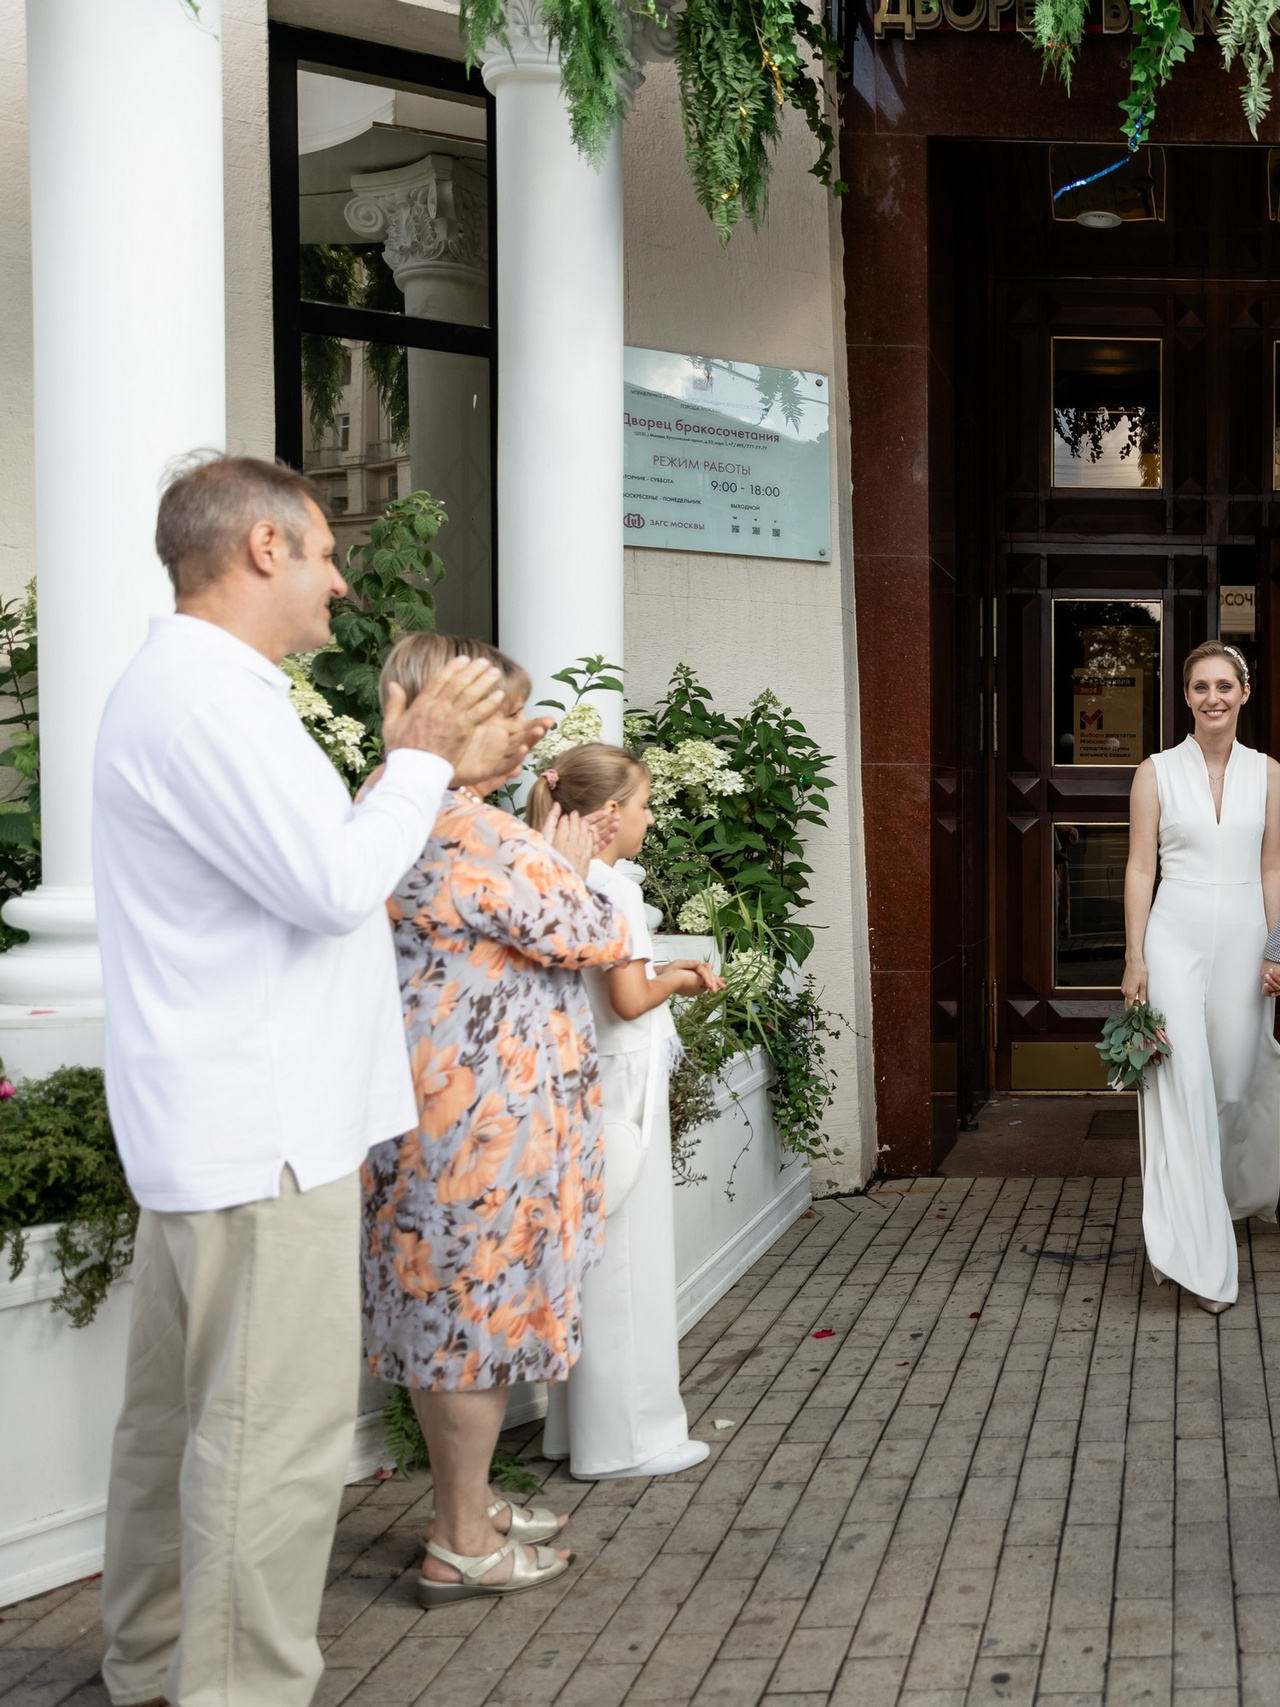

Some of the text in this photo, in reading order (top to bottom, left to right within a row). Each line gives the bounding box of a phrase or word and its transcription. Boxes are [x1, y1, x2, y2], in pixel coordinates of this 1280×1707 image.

[623, 412, 672, 431] Дворец
[675, 419, 780, 443] бракосочетания
[653, 455, 751, 476] РЕЖИМ РАБОТЫ
[711, 480, 737, 493] 9:00
[750, 484, 780, 497] 18:00
[662, 496, 702, 505] ПОНЕДЕЛЬНИК
[730, 503, 760, 511] ВЫХОДНОЙ
[670, 521, 705, 530] МОСКВЫ
